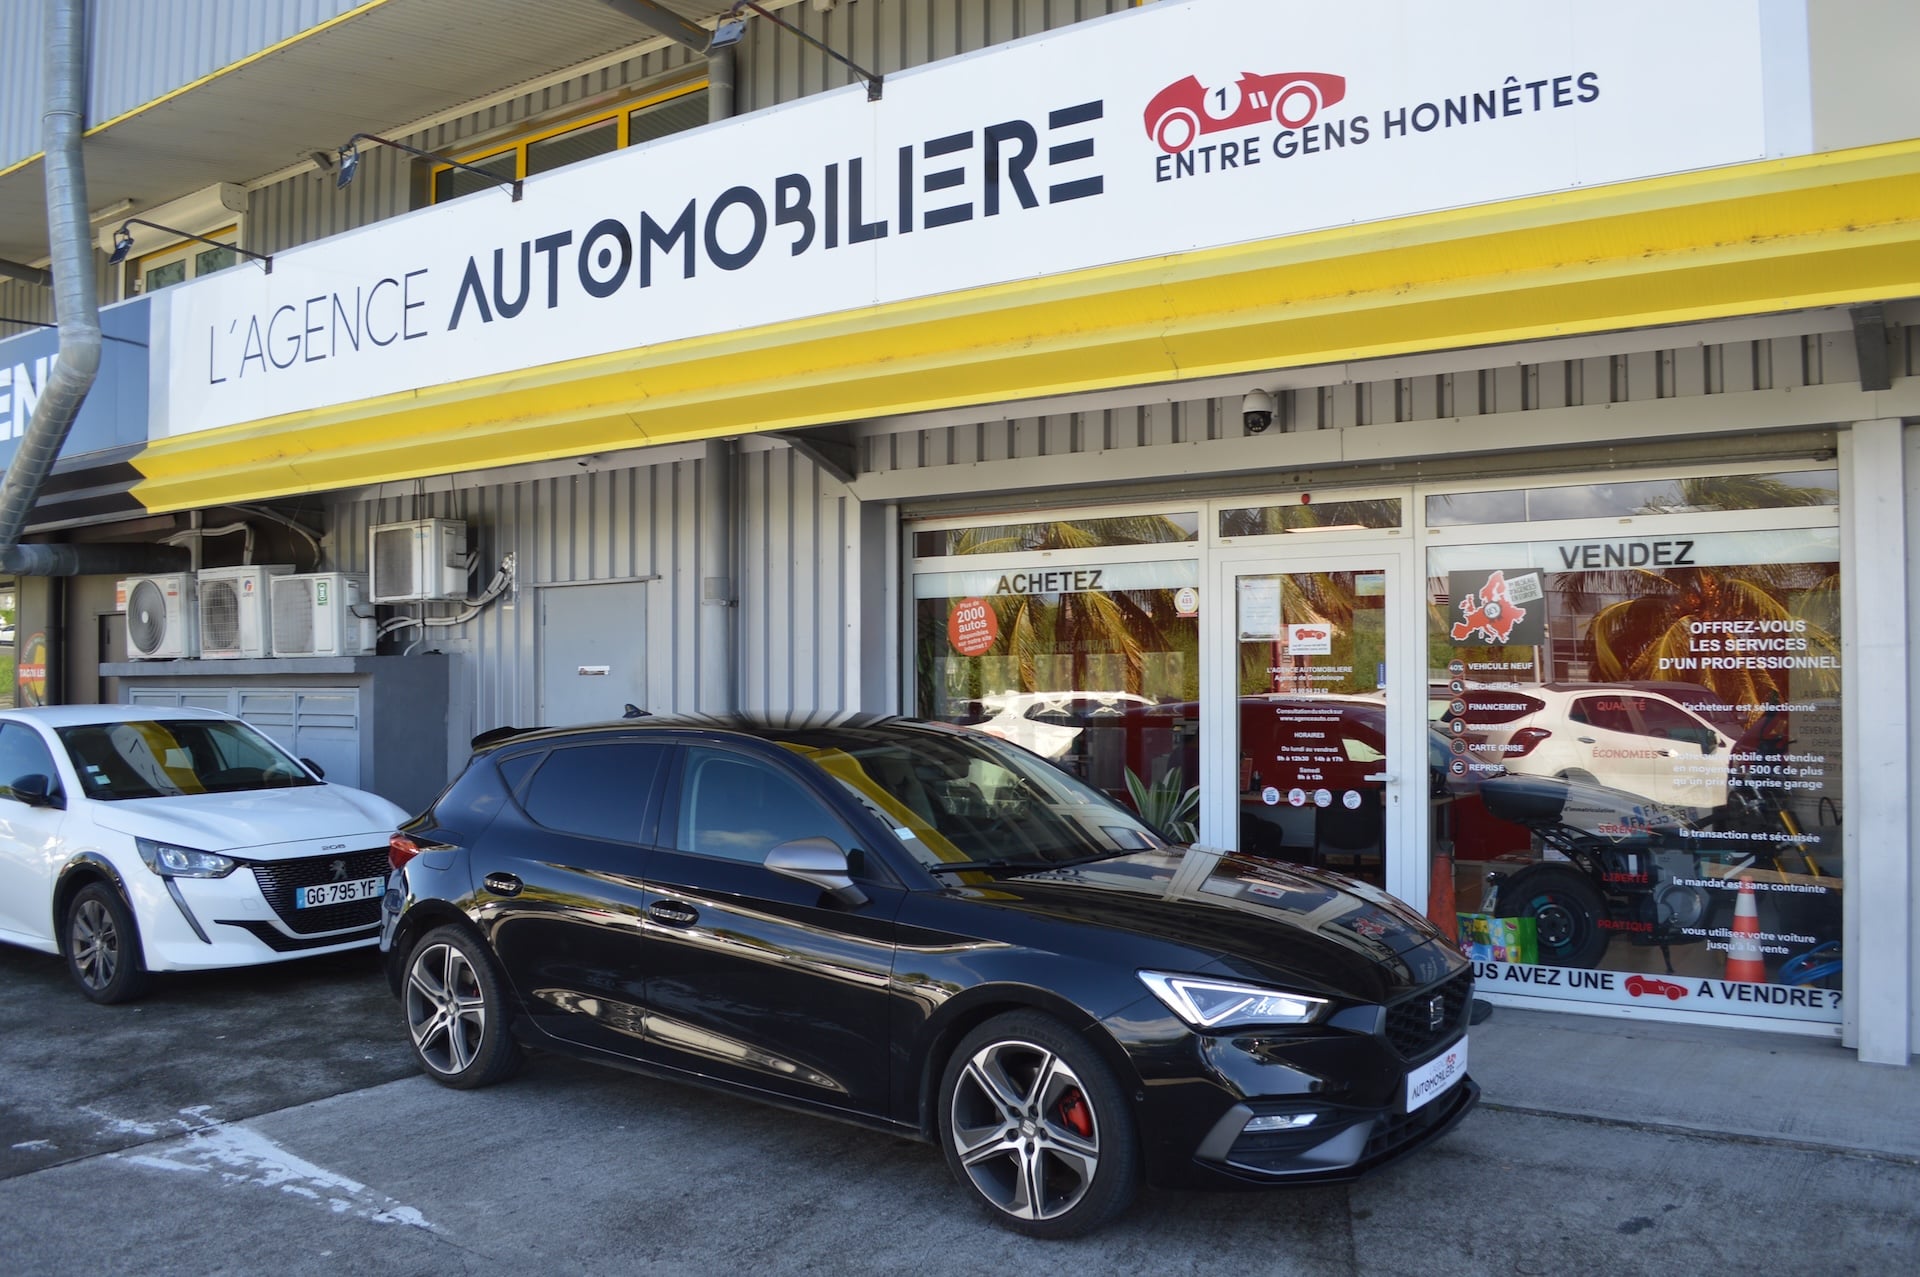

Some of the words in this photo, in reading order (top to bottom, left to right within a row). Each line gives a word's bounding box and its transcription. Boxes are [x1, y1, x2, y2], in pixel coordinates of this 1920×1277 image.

[1156, 136, 1261, 183] ENTRE
[1272, 115, 1370, 159] GENS
[1384, 71, 1601, 140] HONNÊTES
[209, 268, 429, 384] L'AGENCE
[447, 98, 1104, 331] AUTOMOBILIERE
[1558, 540, 1695, 570] VENDEZ
[996, 569, 1103, 594] ACHETEZ
[957, 606, 985, 624] 2000
[959, 619, 987, 633] autos
[1690, 620, 1806, 635] OFFREZ-VOUS
[1689, 638, 1721, 652] LES
[1724, 638, 1807, 652] SERVICES
[1468, 662, 1507, 670] VEHICULE
[1510, 662, 1533, 670] NEUF
[1659, 657, 1697, 670] D'UN
[1701, 655, 1841, 670] PROFESSIONNEL
[1468, 703, 1528, 711] FINANCEMENT
[1735, 703, 1751, 712] est
[1753, 702, 1816, 712] sélectionné
[1469, 723, 1515, 731] GARANTIES
[1469, 744, 1496, 752] CARTE
[1498, 744, 1524, 752] GRISE
[1592, 746, 1658, 759] ÉCONOMIES
[1764, 753, 1781, 762] est
[1784, 752, 1825, 763] vendue
[1469, 763, 1505, 772] REPRISE
[1688, 766, 1737, 774] moyenne
[1773, 766, 1781, 775] €
[1783, 765, 1798, 776] de
[1799, 766, 1824, 778] plus
[1728, 777, 1743, 787] de
[1745, 778, 1781, 790] reprise
[1784, 781, 1824, 791] garage
[1679, 828, 1688, 837] la
[1691, 829, 1749, 840] transaction
[1751, 831, 1767, 841] est
[1769, 832, 1821, 843] sécurisée
[1602, 872, 1649, 884] LIBERTÉ
[1673, 876, 1683, 886] le
[1685, 877, 1725, 889] mandat
[1727, 880, 1743, 890] est
[1745, 880, 1770, 891] sans
[1771, 881, 1827, 894] contrainte
[307, 880, 376, 905] GG-795-YF
[1597, 918, 1654, 933] PRATIQUE
[1681, 926, 1707, 936] vous
[1708, 926, 1745, 939] utilisez
[1748, 931, 1775, 942] votre
[1777, 932, 1816, 944] voiture
[1759, 944, 1790, 955] vente
[1505, 965, 1561, 986] AVEZ
[1568, 970, 1615, 990] UNE
[1697, 980, 1714, 998] A
[1720, 982, 1824, 1008] VENDRE
